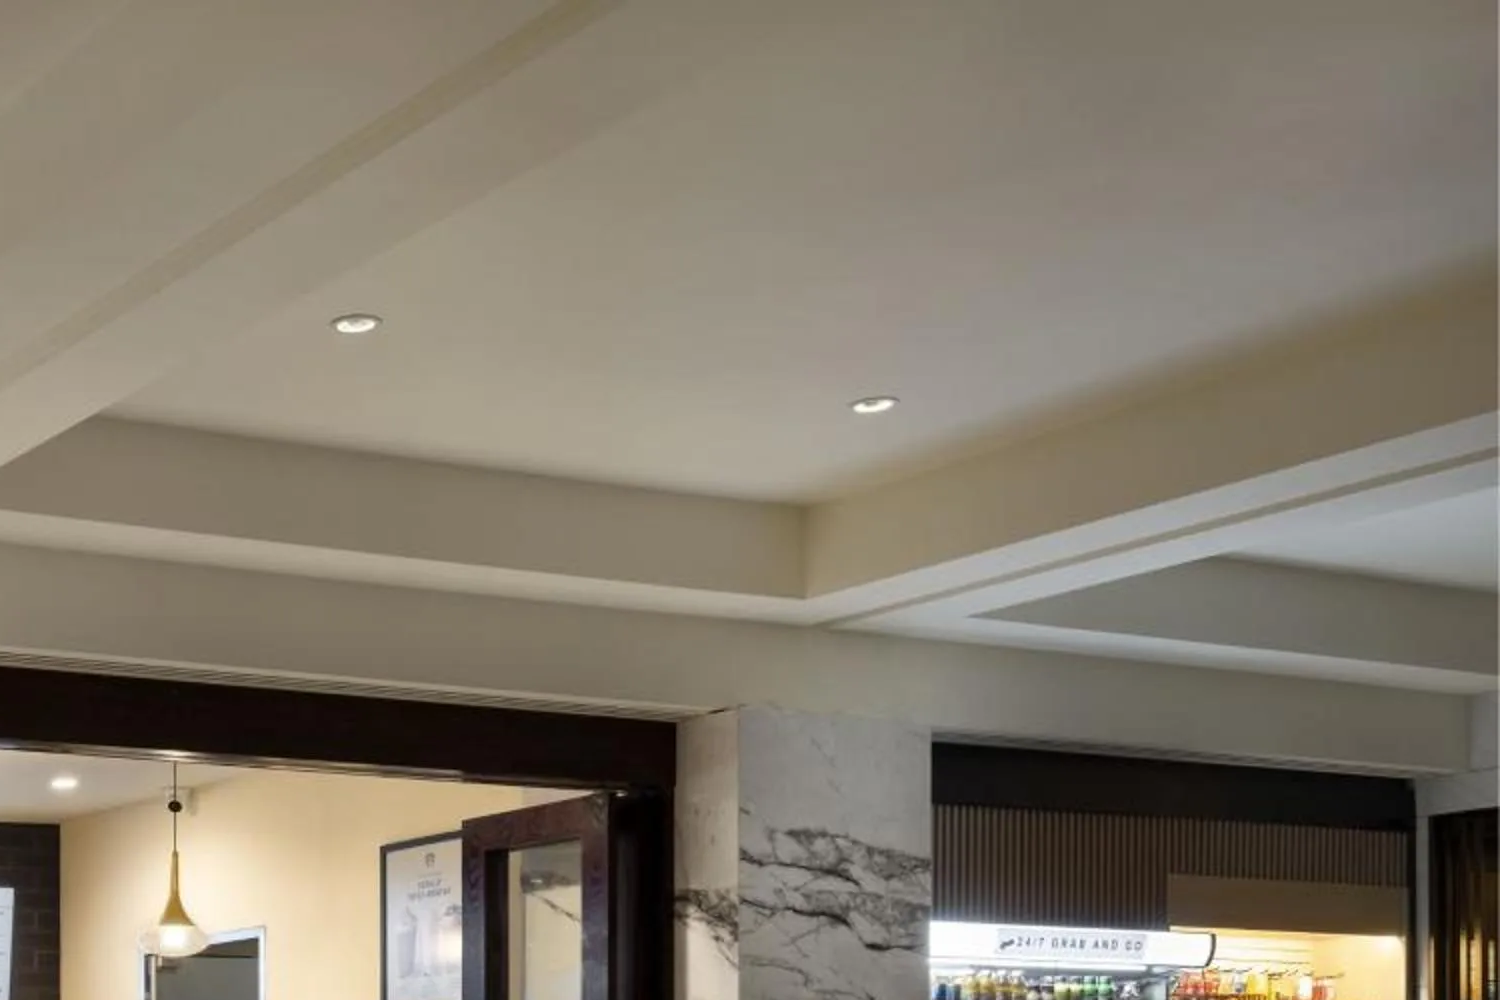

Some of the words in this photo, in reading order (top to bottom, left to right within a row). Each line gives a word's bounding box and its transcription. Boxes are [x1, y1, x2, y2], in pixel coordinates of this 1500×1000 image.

[1016, 936, 1045, 948] 24/7
[1051, 937, 1087, 950] GRAB
[1092, 938, 1119, 951] AND
[1125, 939, 1144, 952] GO
